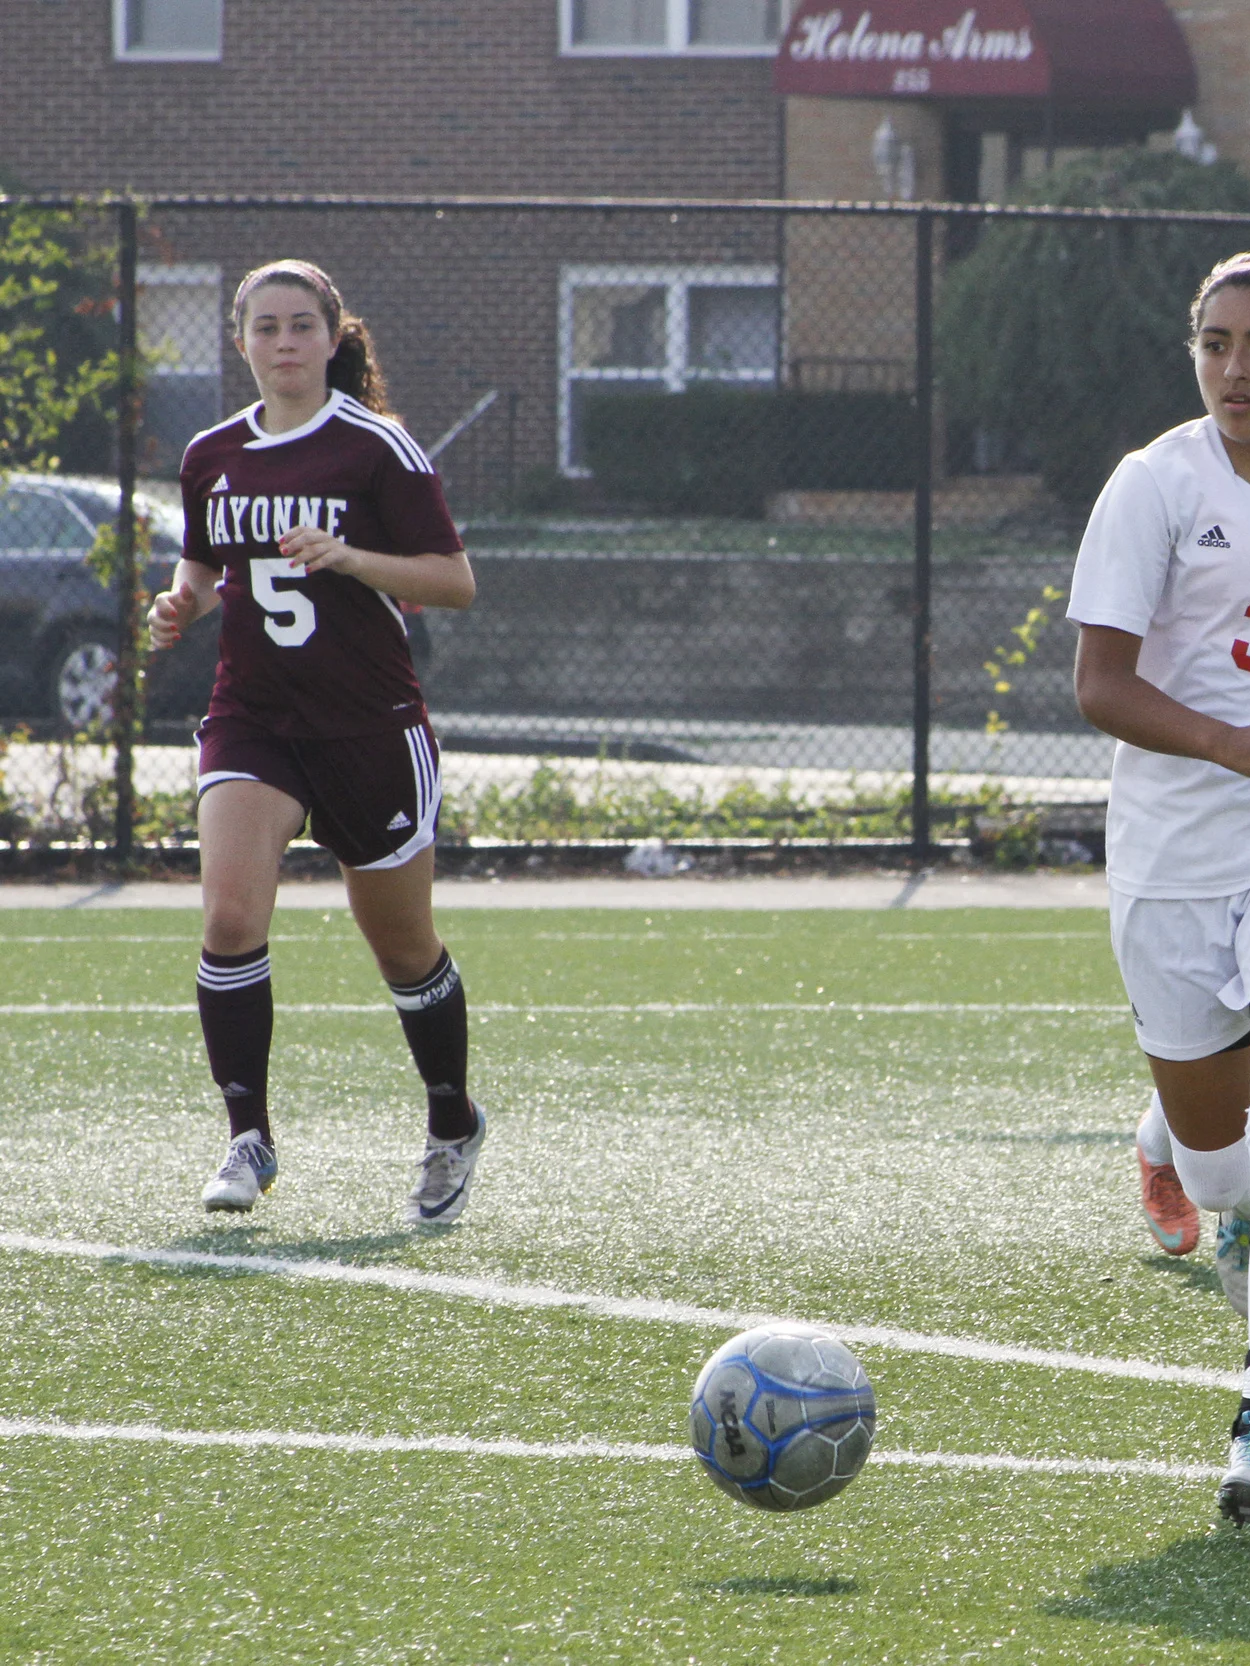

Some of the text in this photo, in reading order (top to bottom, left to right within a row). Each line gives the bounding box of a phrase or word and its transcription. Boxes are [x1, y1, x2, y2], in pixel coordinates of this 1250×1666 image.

[790, 8, 1034, 62] Helena Arms
[1197, 537, 1231, 548] adidas
[249, 558, 318, 647] 5
